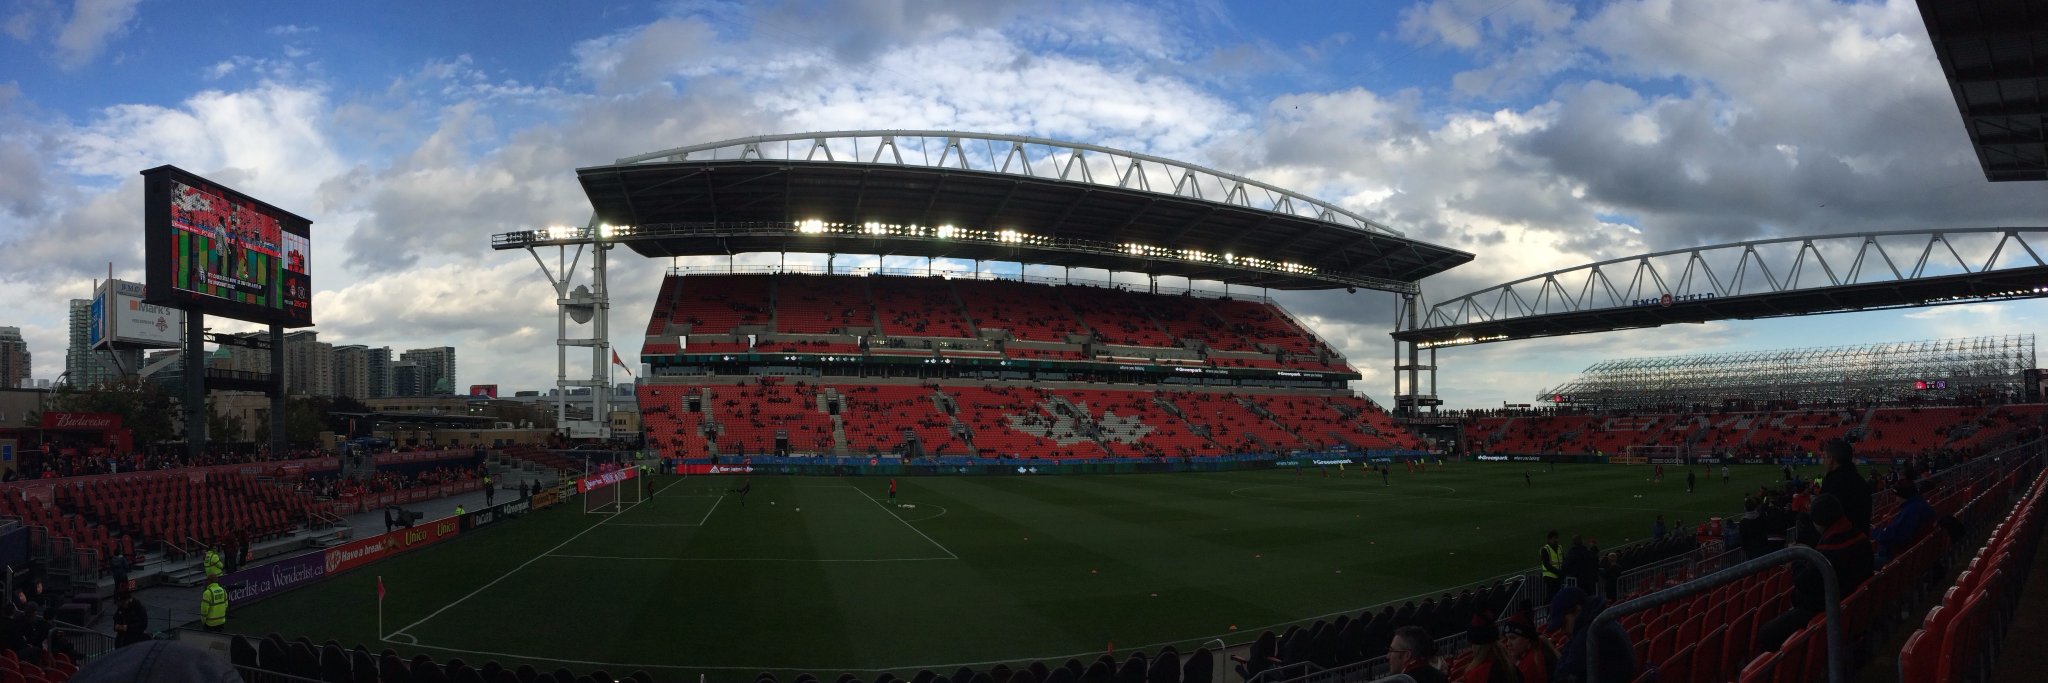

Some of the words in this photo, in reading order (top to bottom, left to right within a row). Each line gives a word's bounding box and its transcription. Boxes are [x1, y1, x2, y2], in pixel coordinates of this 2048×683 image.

[1632, 298, 1658, 306] BMO
[1675, 293, 1715, 302] FIELD
[139, 302, 170, 316] Mark's
[56, 413, 110, 426] Budweiser
[437, 521, 456, 537] Unico
[405, 529, 427, 546] Unico
[341, 549, 358, 562] Have
[358, 549, 363, 558] a
